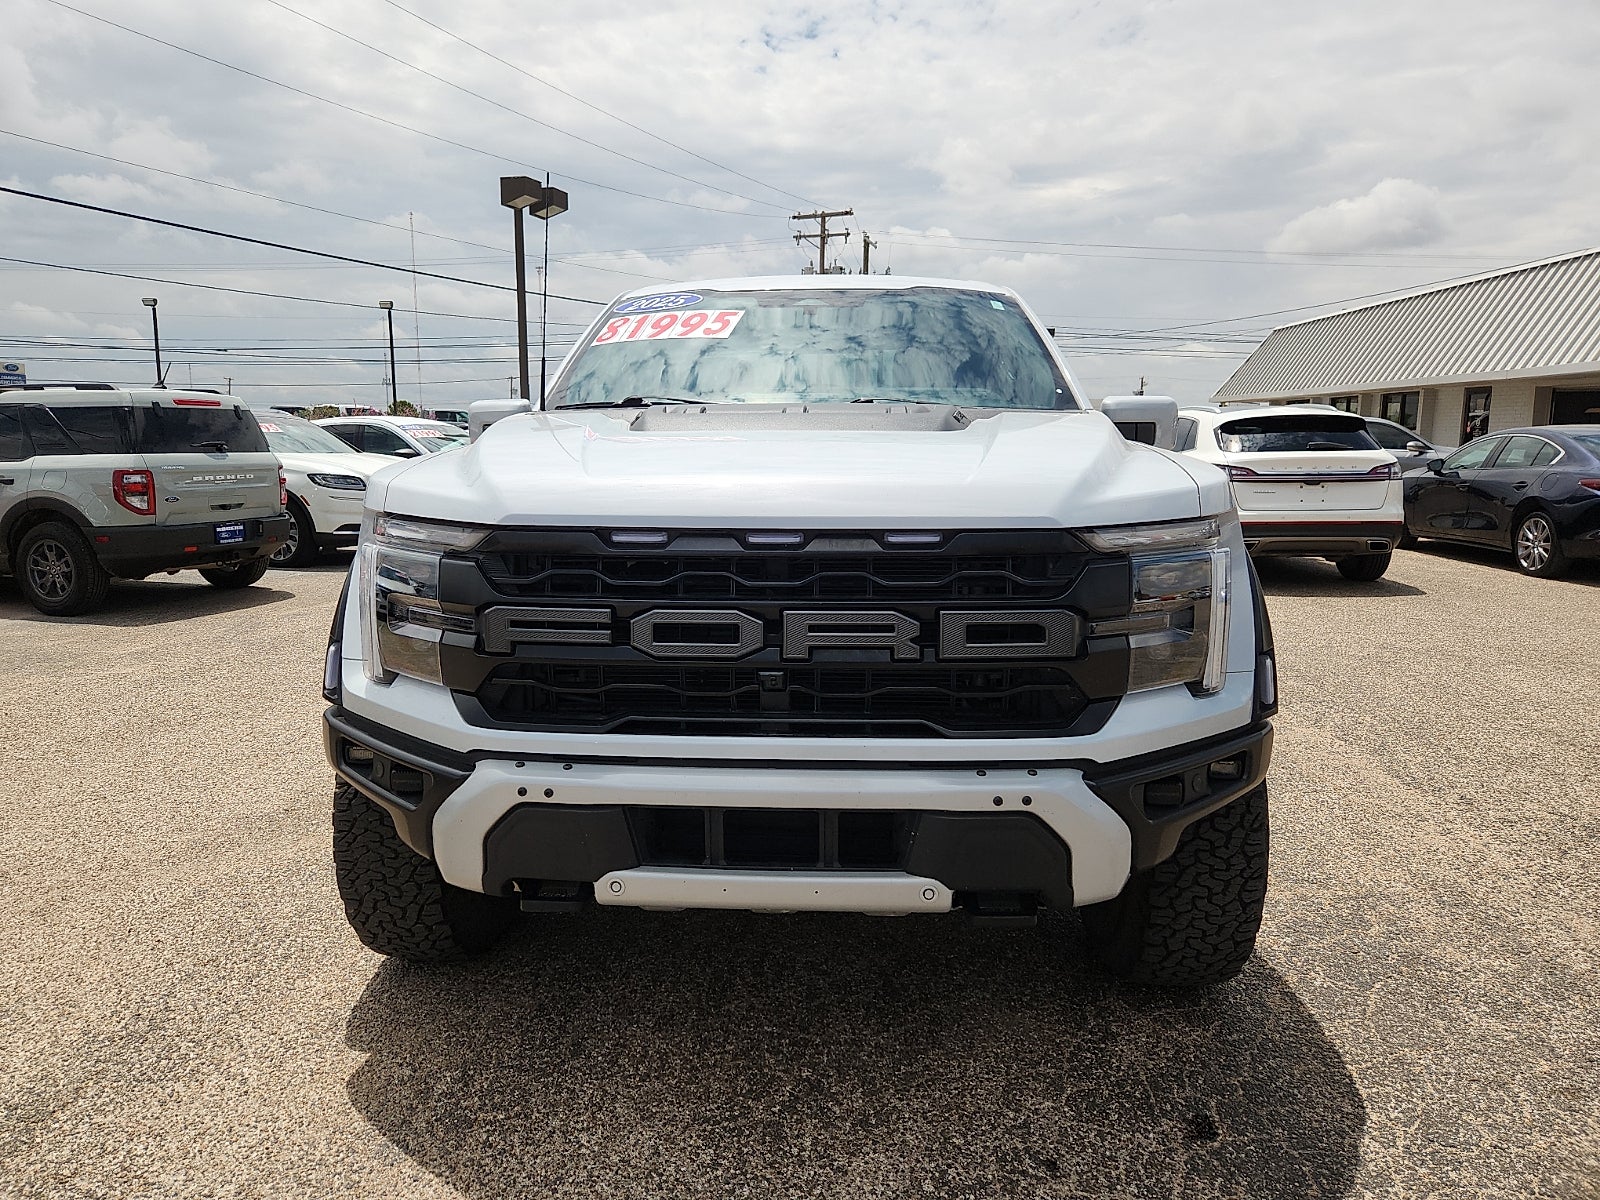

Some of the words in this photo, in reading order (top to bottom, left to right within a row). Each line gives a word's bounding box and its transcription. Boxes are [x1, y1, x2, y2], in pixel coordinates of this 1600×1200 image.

[630, 293, 689, 309] 2025
[595, 311, 740, 343] 81995
[483, 605, 1083, 662] FORD
